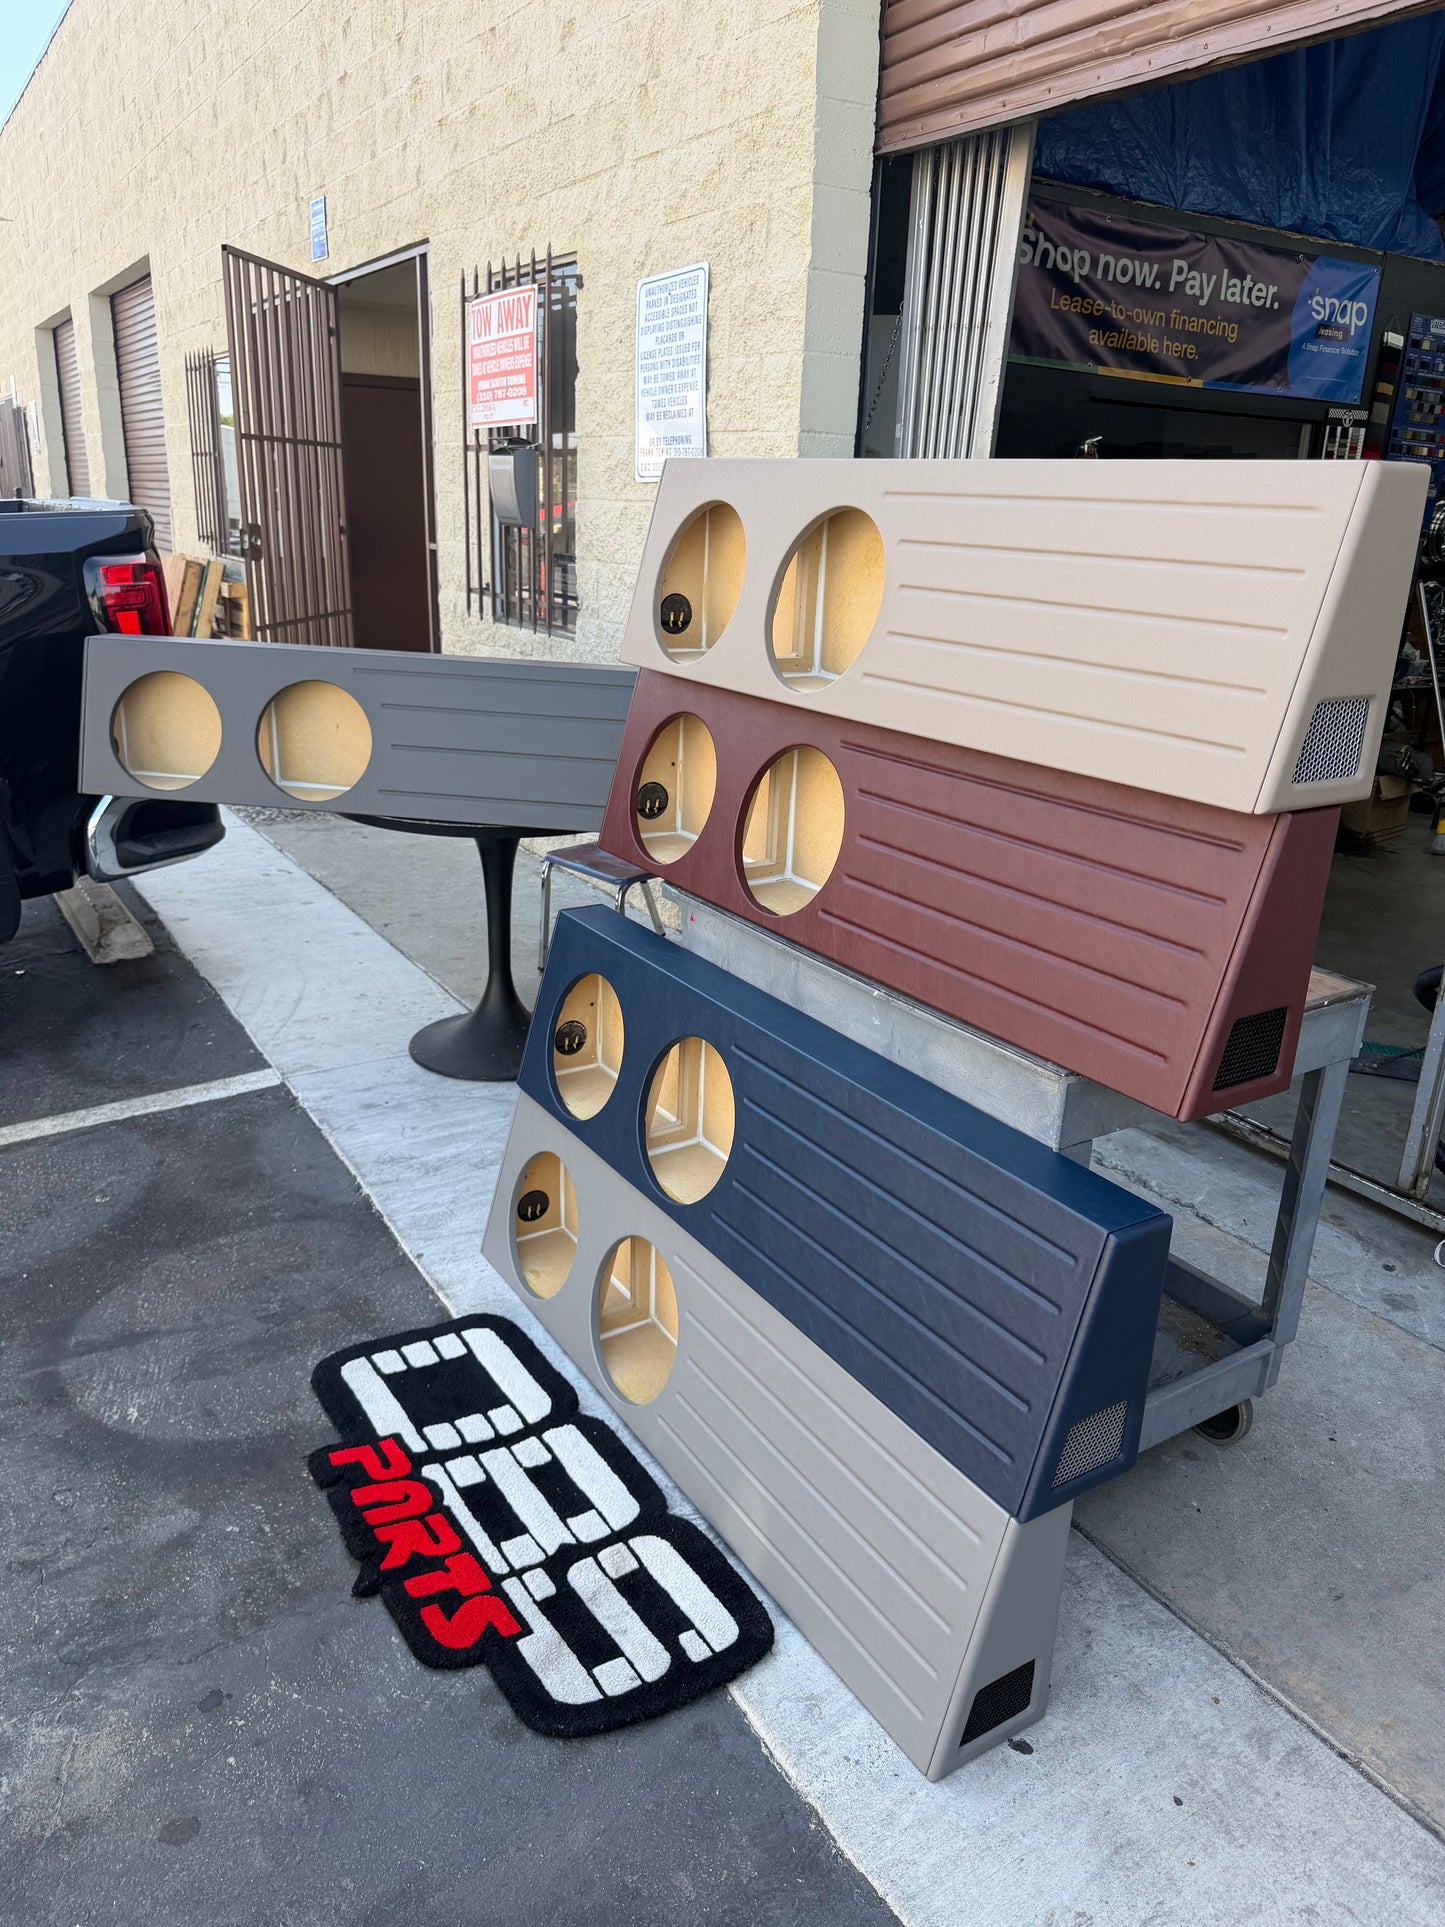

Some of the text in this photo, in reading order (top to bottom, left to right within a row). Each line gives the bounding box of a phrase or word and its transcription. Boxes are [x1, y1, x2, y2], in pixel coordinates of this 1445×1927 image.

[1020, 228, 1280, 310] Shop now. Pay later.
[679, 275, 699, 289] VEHICLES
[646, 289, 697, 309] PARKED IN DESIGNATED
[471, 294, 532, 340] TOW AWAY
[645, 302, 698, 322] ACCESSIBLE SPACES NOT
[1050, 288, 1239, 343] Lease-to-own financing
[1311, 295, 1368, 336] snap
[641, 322, 665, 336] DISPLAYING
[1318, 326, 1343, 340] leasing
[655, 331, 685, 346] PLACARDS OR
[1088, 328, 1199, 361] available here.
[641, 341, 700, 361] LICENSE PLATES ISSUED FOR
[1306, 342, 1319, 352] Snap
[1319, 344, 1340, 354] Finance
[640, 361, 658, 373] PERSONS
[660, 359, 671, 370] WITH
[654, 373, 659, 383] BE
[661, 371, 675, 382] TOWED
[476, 386, 528, 404] (310) 787-0208
[668, 395, 687, 407] VEHICLES
[656, 411, 661, 421] BE
[328, 1437, 522, 1649] PARTS
